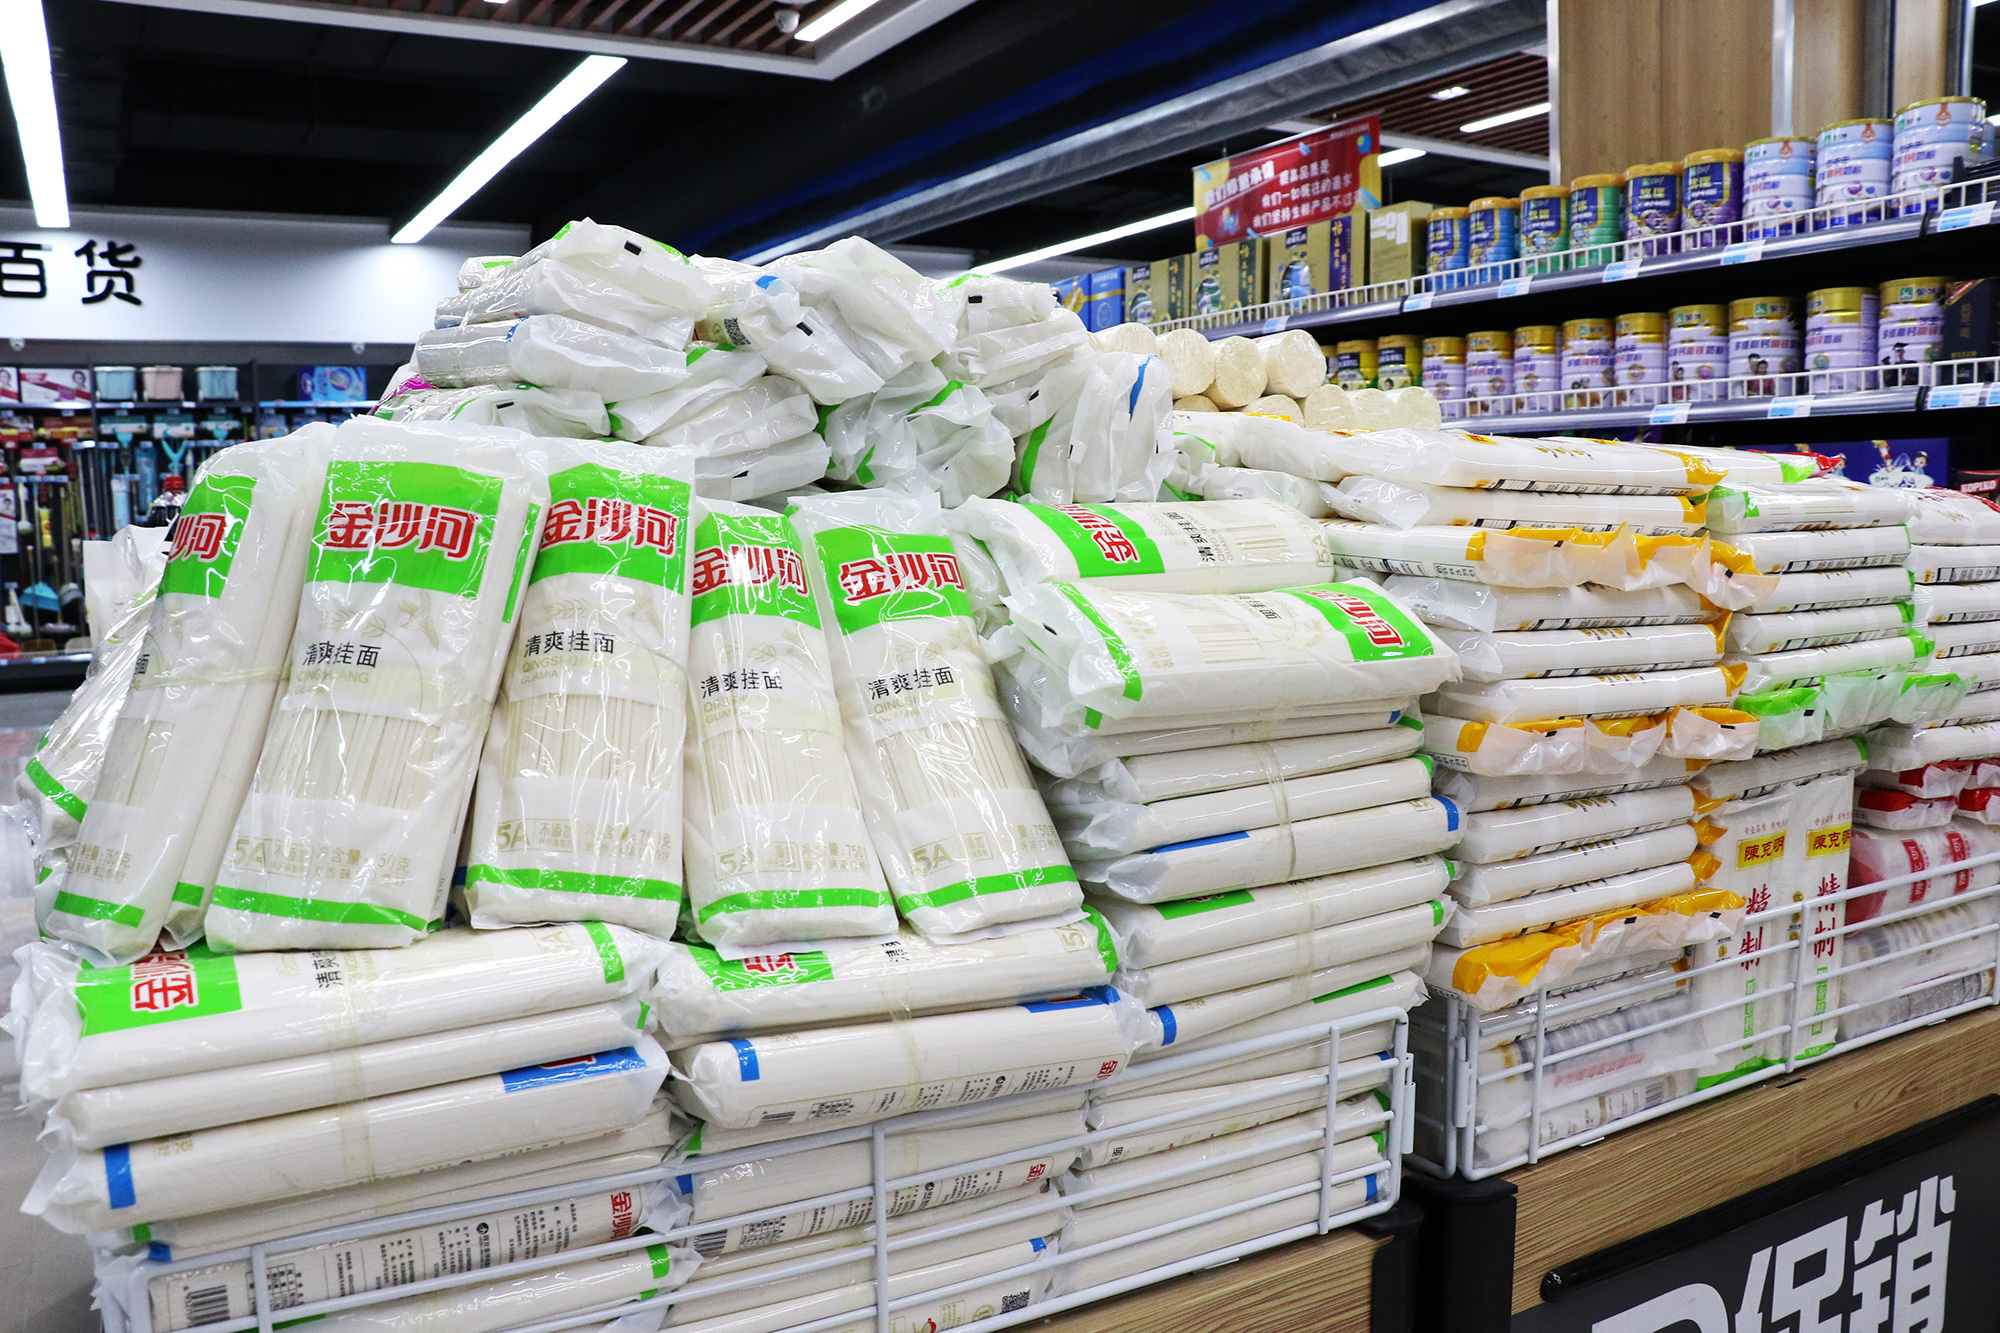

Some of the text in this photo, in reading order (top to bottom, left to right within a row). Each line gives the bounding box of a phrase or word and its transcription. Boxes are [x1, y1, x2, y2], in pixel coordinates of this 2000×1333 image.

[0, 240, 142, 305] 百货
[1961, 480, 1997, 493] KOPIKO
[323, 502, 480, 558] 金沙河
[541, 499, 678, 557] 金沙河
[692, 546, 808, 596] 金沙河
[841, 553, 966, 600] 金沙河
[302, 640, 382, 668] 清爽挂面
[524, 630, 616, 658] 清爽挂面
[701, 668, 783, 699] 清爽挂面
[869, 666, 954, 700] 清爽挂面
[497, 821, 530, 849] 5A
[1744, 835, 1785, 862] 陳克明
[1812, 828, 1851, 851] 陳克明
[234, 839, 266, 867] 5A
[913, 843, 953, 875] 5A
[1738, 883, 1771, 971] 精制
[1813, 872, 1841, 959] 精制
[610, 1191, 633, 1240] 金沙河
